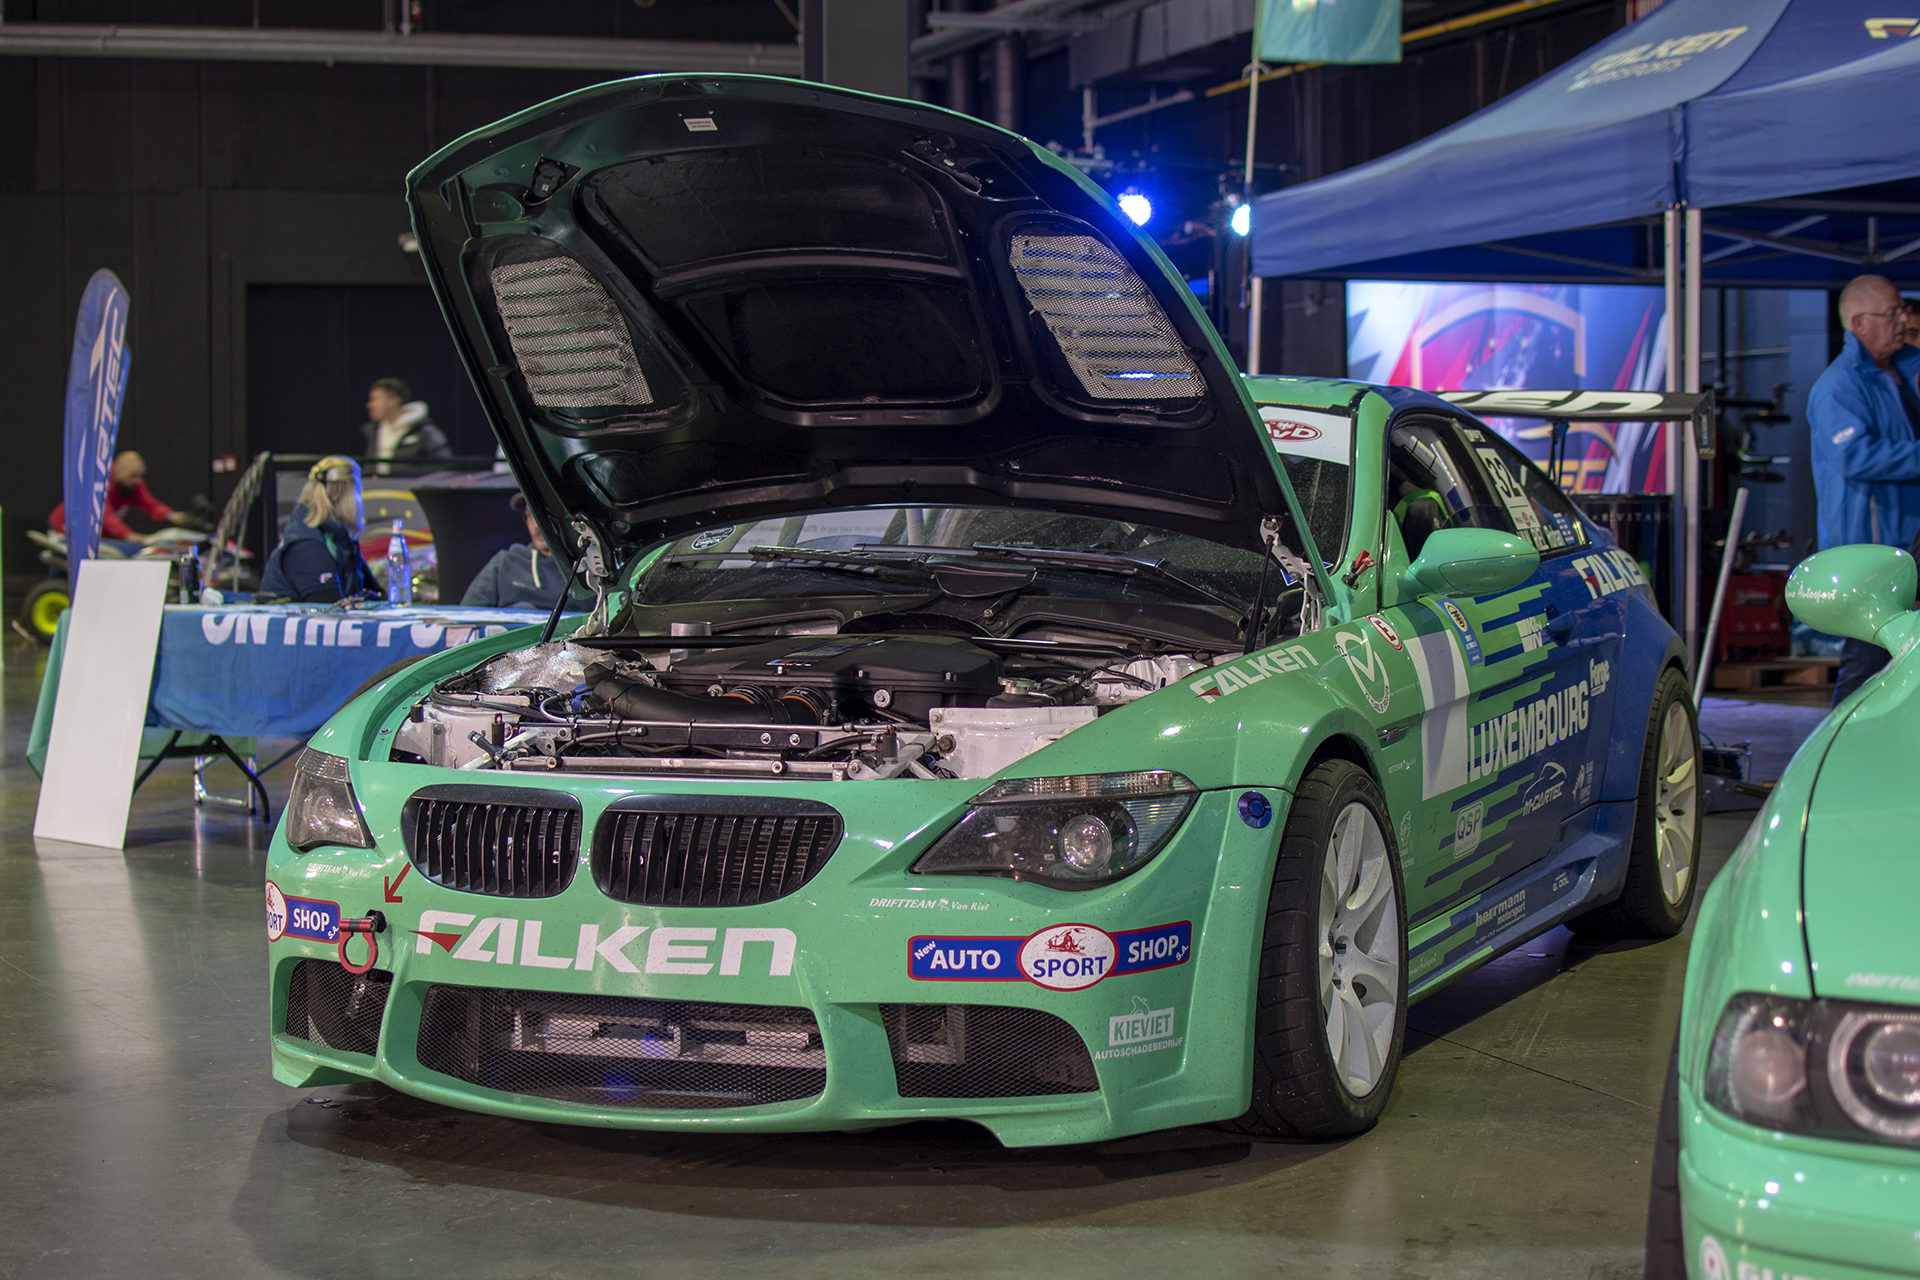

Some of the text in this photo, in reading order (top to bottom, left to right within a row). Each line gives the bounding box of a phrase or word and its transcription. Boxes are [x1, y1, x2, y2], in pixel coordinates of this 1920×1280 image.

[1484, 457, 1522, 498] 32
[1189, 644, 1319, 704] FALKEN
[1469, 680, 1589, 783] LUXEMBOURG
[1457, 808, 1481, 841] QSP
[267, 910, 284, 932] ORT
[293, 908, 330, 932] SHOP
[869, 898, 990, 911] DRIFTTEAM Van Riel
[1475, 890, 1526, 928] herrmann
[1497, 900, 1526, 926] motorsport
[407, 909, 798, 977] FALKEN
[914, 940, 937, 960] New
[930, 949, 1002, 970] AUTO
[1033, 956, 1108, 978] SPORT
[1128, 934, 1180, 963] SHOP
[1114, 1014, 1172, 1042] KIEVIET
[1094, 1036, 1184, 1060] AUTOSCHADEBEDRIJF
